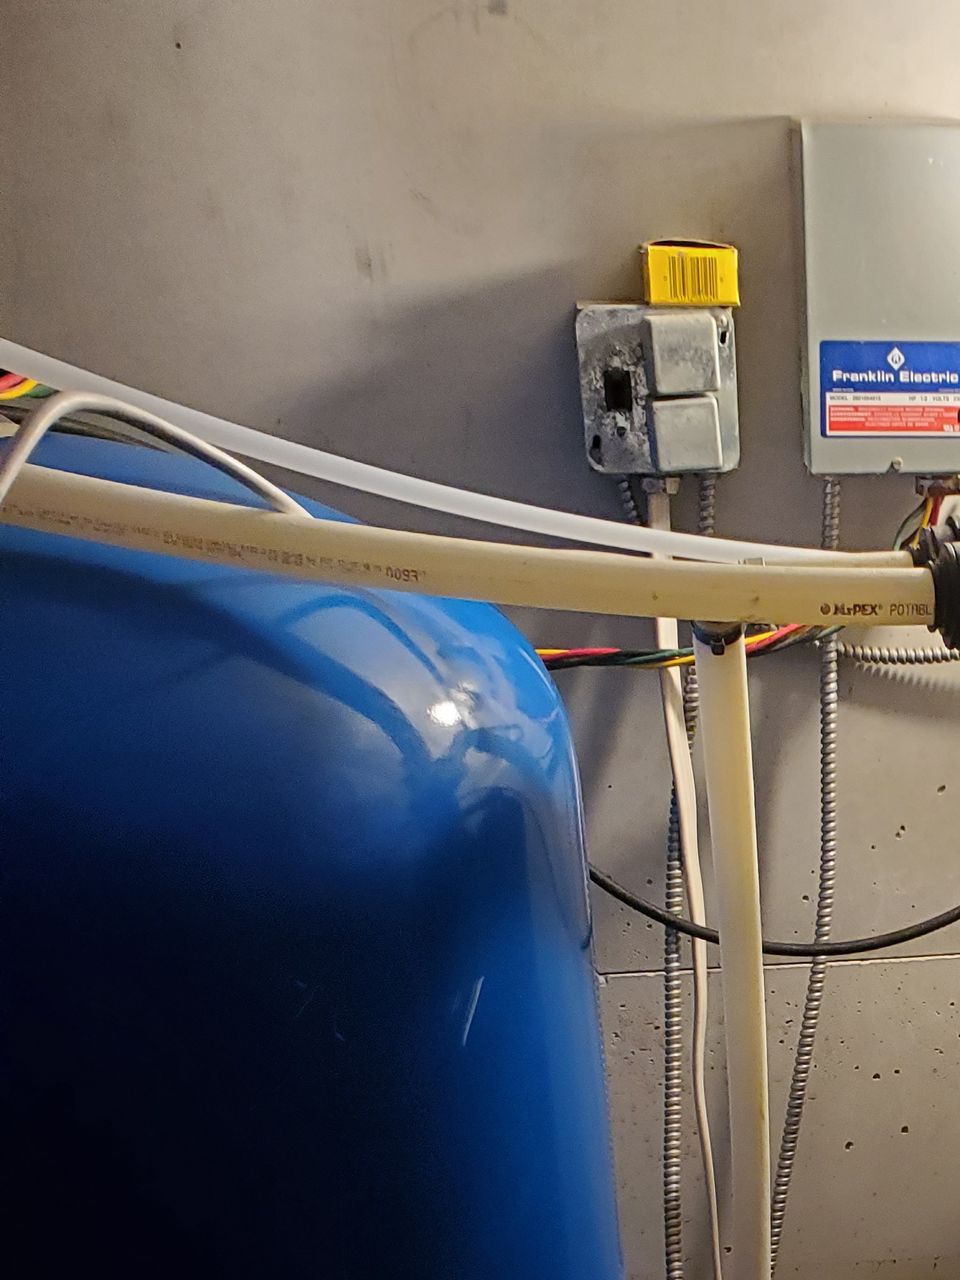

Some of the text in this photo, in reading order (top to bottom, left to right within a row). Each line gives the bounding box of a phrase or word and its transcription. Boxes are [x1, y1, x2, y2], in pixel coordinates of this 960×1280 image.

[832, 370, 960, 383] Franklin Electric
[889, 604, 933, 616] POTABL
